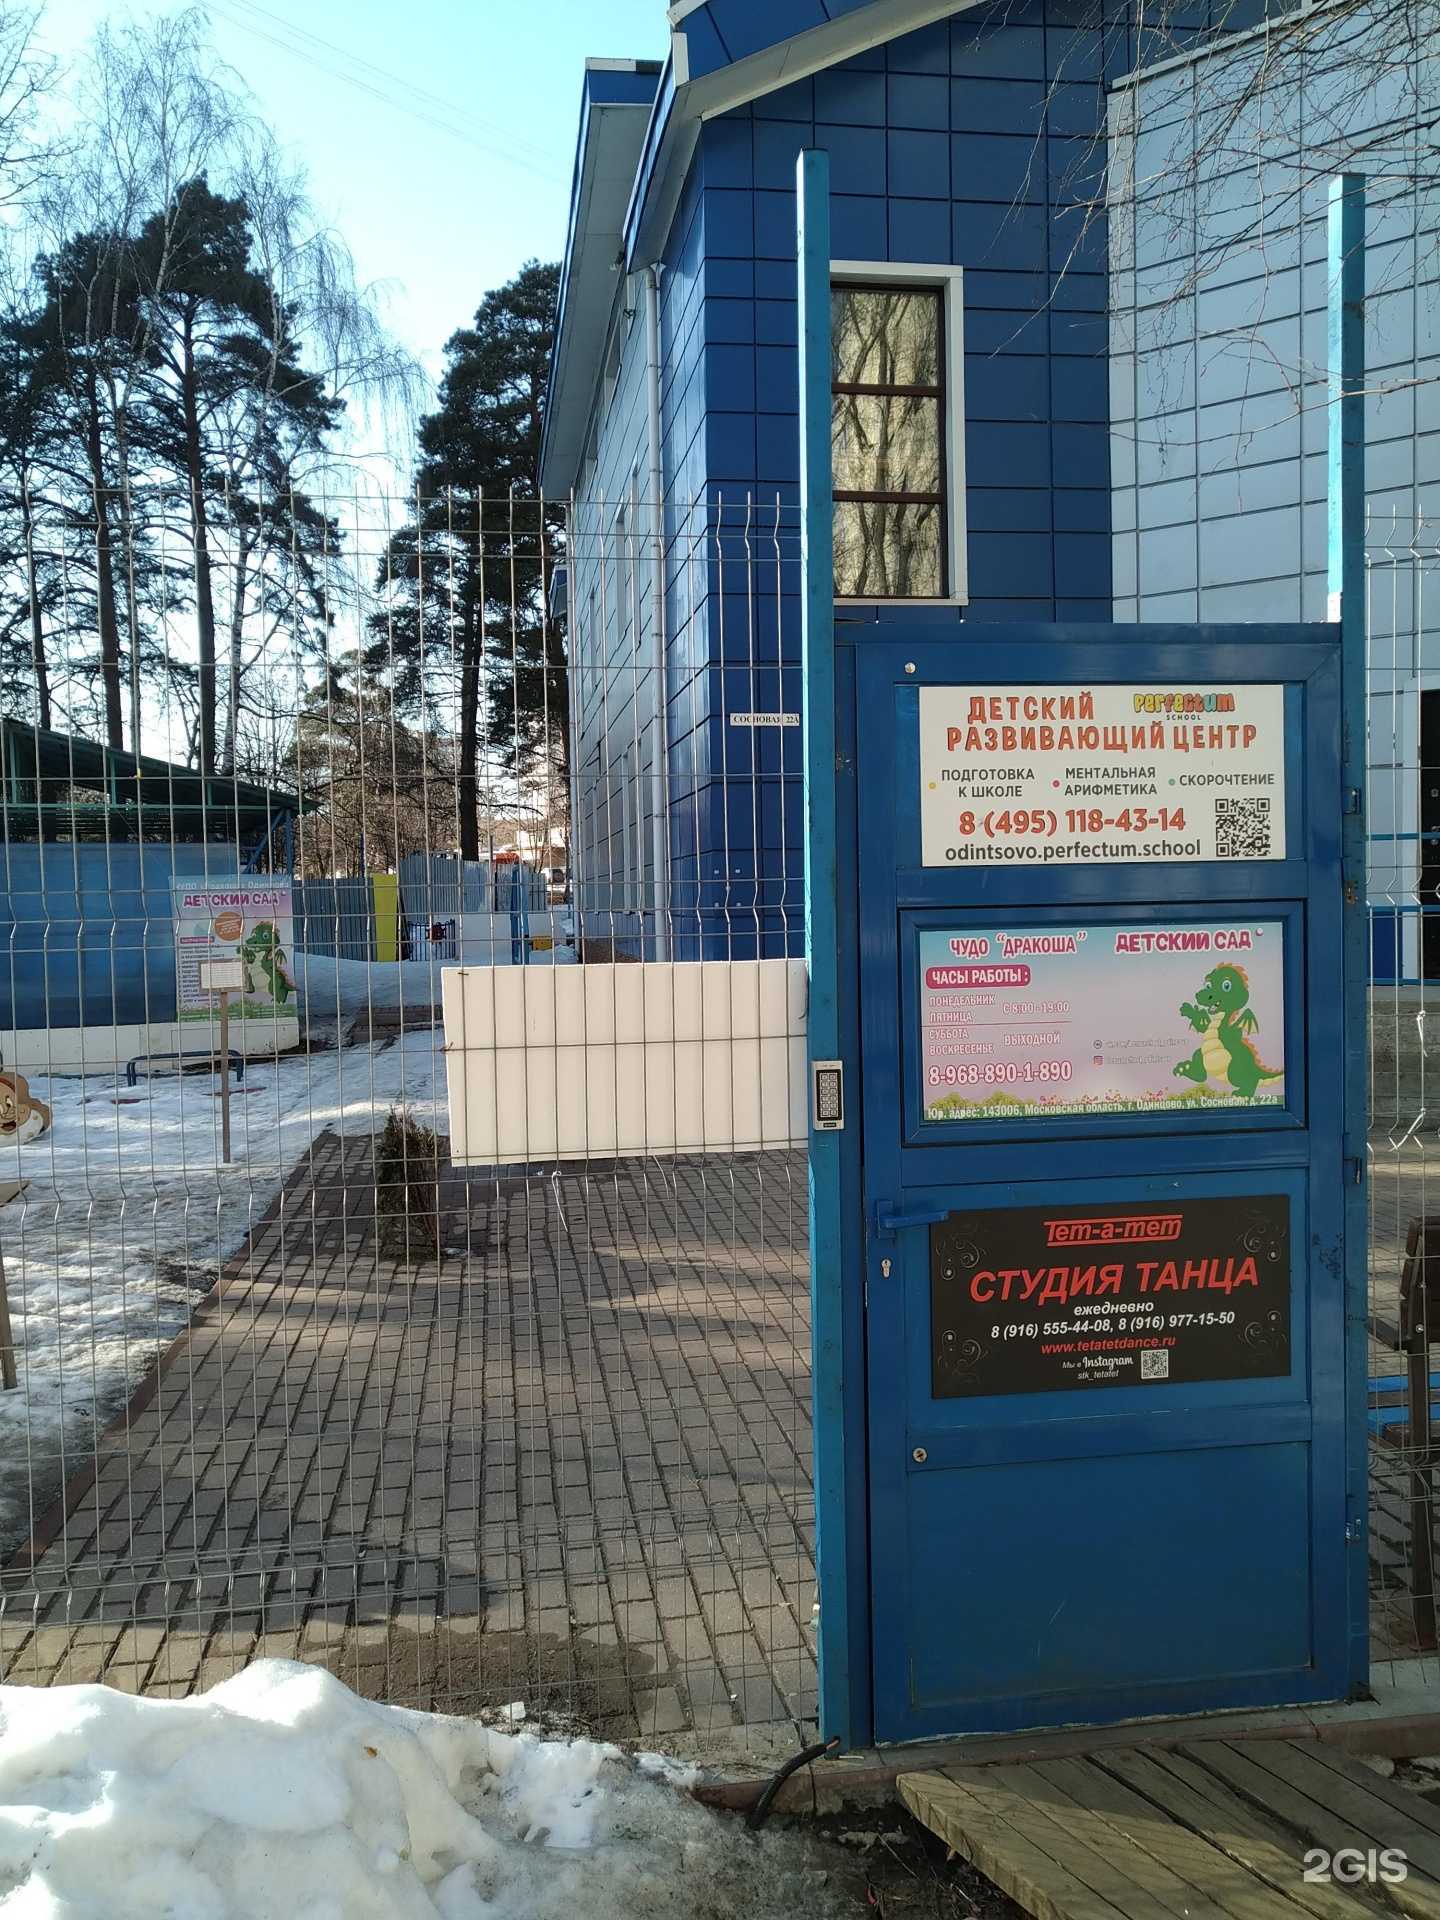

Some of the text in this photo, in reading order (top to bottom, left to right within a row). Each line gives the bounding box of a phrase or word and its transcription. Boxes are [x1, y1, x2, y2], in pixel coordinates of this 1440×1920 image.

[968, 691, 1094, 724] ДЕТСКИЙ
[947, 721, 1258, 753] РАЗВИВАЮЩИЙ ЦЕНТР
[941, 767, 1035, 783] ПОДГОТОВКА
[1065, 766, 1156, 781] МЕНТАЛЬНАЯ
[1179, 773, 1275, 787] СКОРОЧТЕНИЕ
[958, 785, 1023, 798] К ШКОЛЕ
[1064, 783, 1158, 797] АРИФМЕТИКА
[959, 808, 1186, 837] 8 (495) 118-43-14
[945, 839, 1201, 862] odintsovo.perfectum.school
[1214, 930, 1252, 949] САД
[950, 939, 989, 958] ЧУДО
[932, 970, 969, 985] ЧАСЫ
[929, 994, 996, 1007] ПОНЕДЕЛЬНИК
[1003, 1003, 1011, 1014] С
[1012, 1002, 1035, 1014] 8:00
[1042, 1001, 1070, 1014] 19:00
[929, 1012, 974, 1023] ПЯТНИЦА
[929, 1028, 969, 1039] СУББОТА
[1003, 1032, 1061, 1046] ВЫХОДНОЙ
[929, 1043, 994, 1056] ВОСКРЕСЕНЬЕ
[929, 1060, 1073, 1086] 8-968-890-1-890
[928, 1107, 946, 1120] Юр.
[950, 1107, 980, 1120] адрес:
[983, 1104, 1023, 1118] 143006,
[1025, 1103, 1084, 1115] Московская
[1086, 1100, 1124, 1113] область,
[1128, 1102, 1134, 1111] г.
[1136, 1099, 1184, 1112] Одинцово,
[1260, 1095, 1278, 1105] 22а
[969, 1256, 1258, 1305] СТУДИЯ ТАНЦА
[1073, 1301, 1154, 1316] ежедневно
[991, 1311, 1235, 1341] 8 (916) 555-44-08, 8 (916) 977-15-50
[1041, 1336, 1176, 1354] www.tetatetdance.ru
[1082, 1356, 1134, 1371] Instagram
